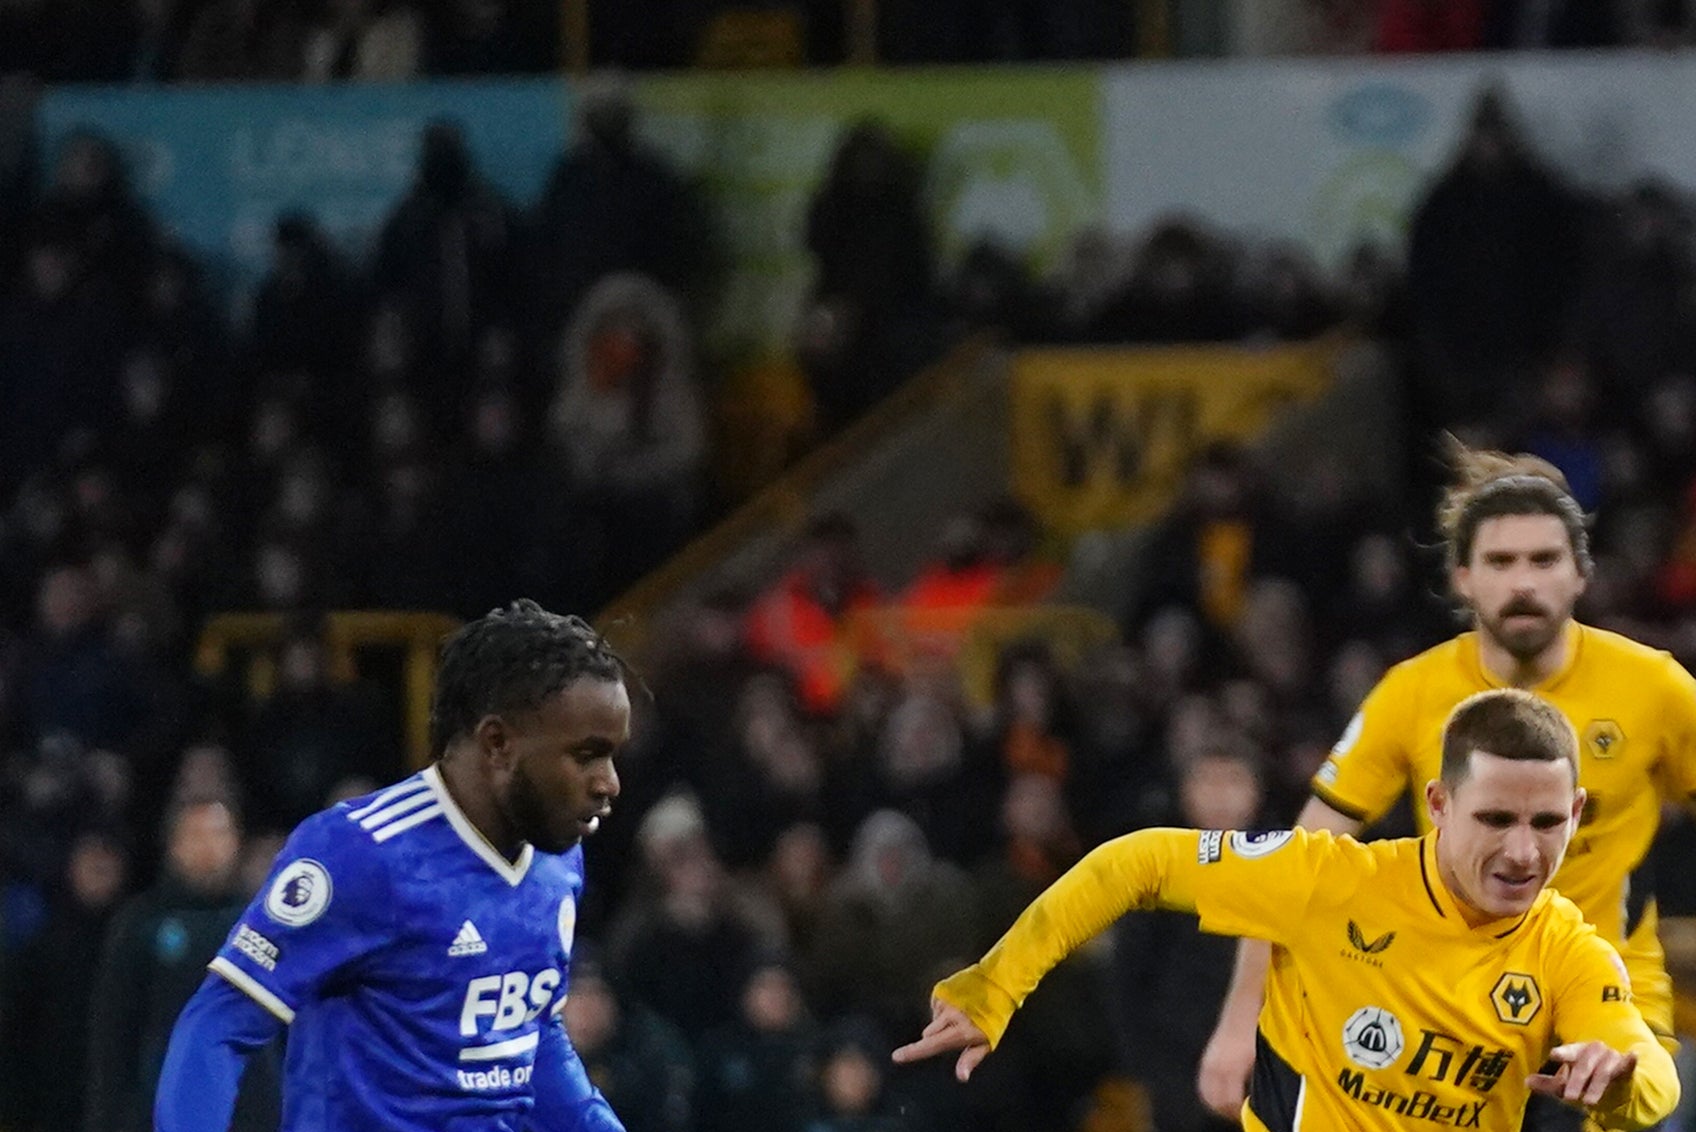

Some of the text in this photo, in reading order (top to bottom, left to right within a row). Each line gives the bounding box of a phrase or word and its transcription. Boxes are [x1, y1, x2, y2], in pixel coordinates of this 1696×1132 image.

[459, 967, 561, 1038] FBS
[457, 1064, 510, 1092] trade
[1404, 1028, 1515, 1093] 万博
[1337, 1067, 1488, 1129] ManBetX
